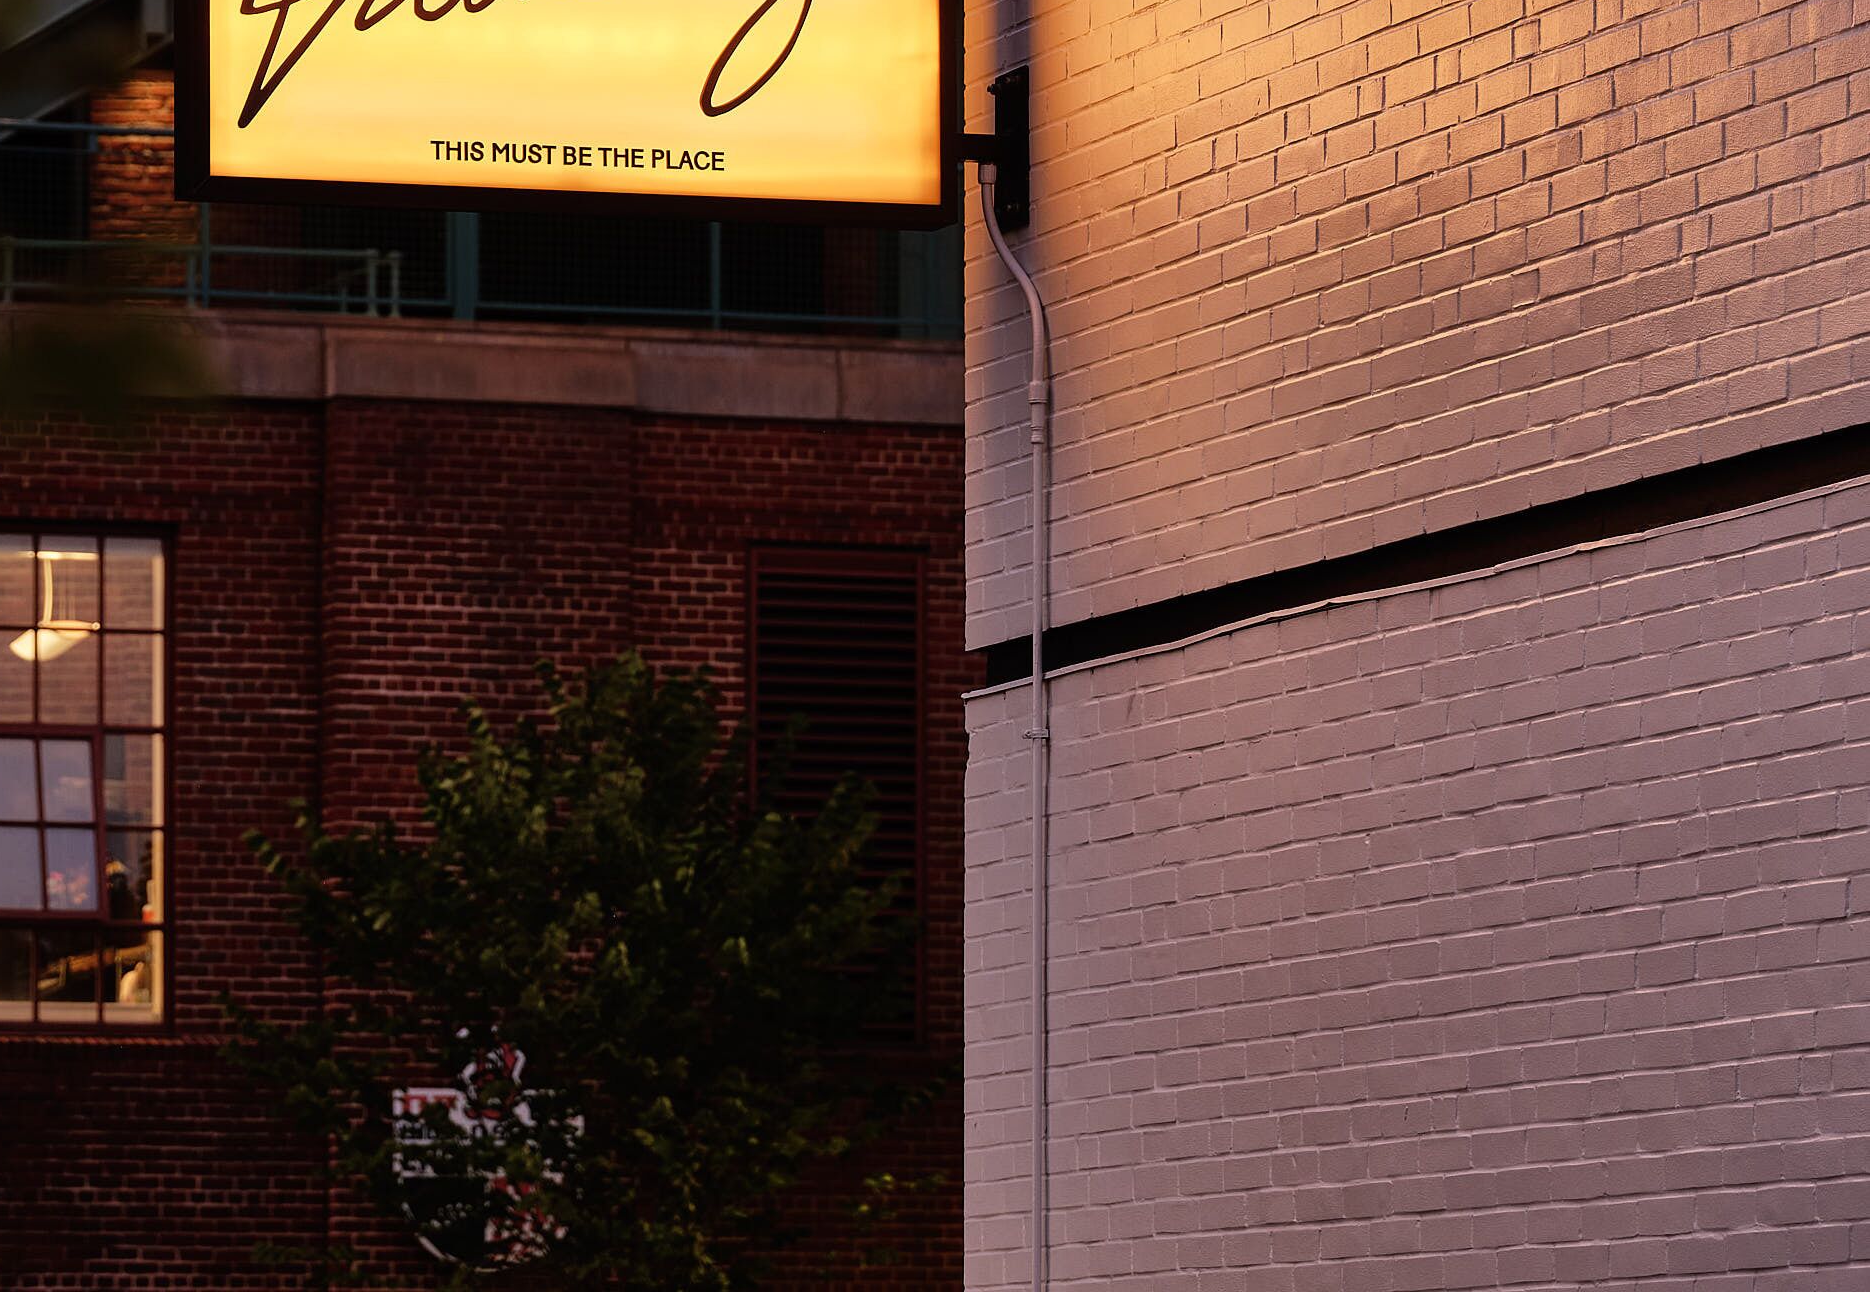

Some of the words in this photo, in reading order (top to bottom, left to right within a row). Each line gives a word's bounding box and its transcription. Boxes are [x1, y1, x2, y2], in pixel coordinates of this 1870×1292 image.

[430, 140, 484, 161] THIS
[492, 142, 557, 165] MUST
[563, 146, 593, 167] BE
[598, 147, 645, 168] THE
[651, 149, 726, 171] PLACE
